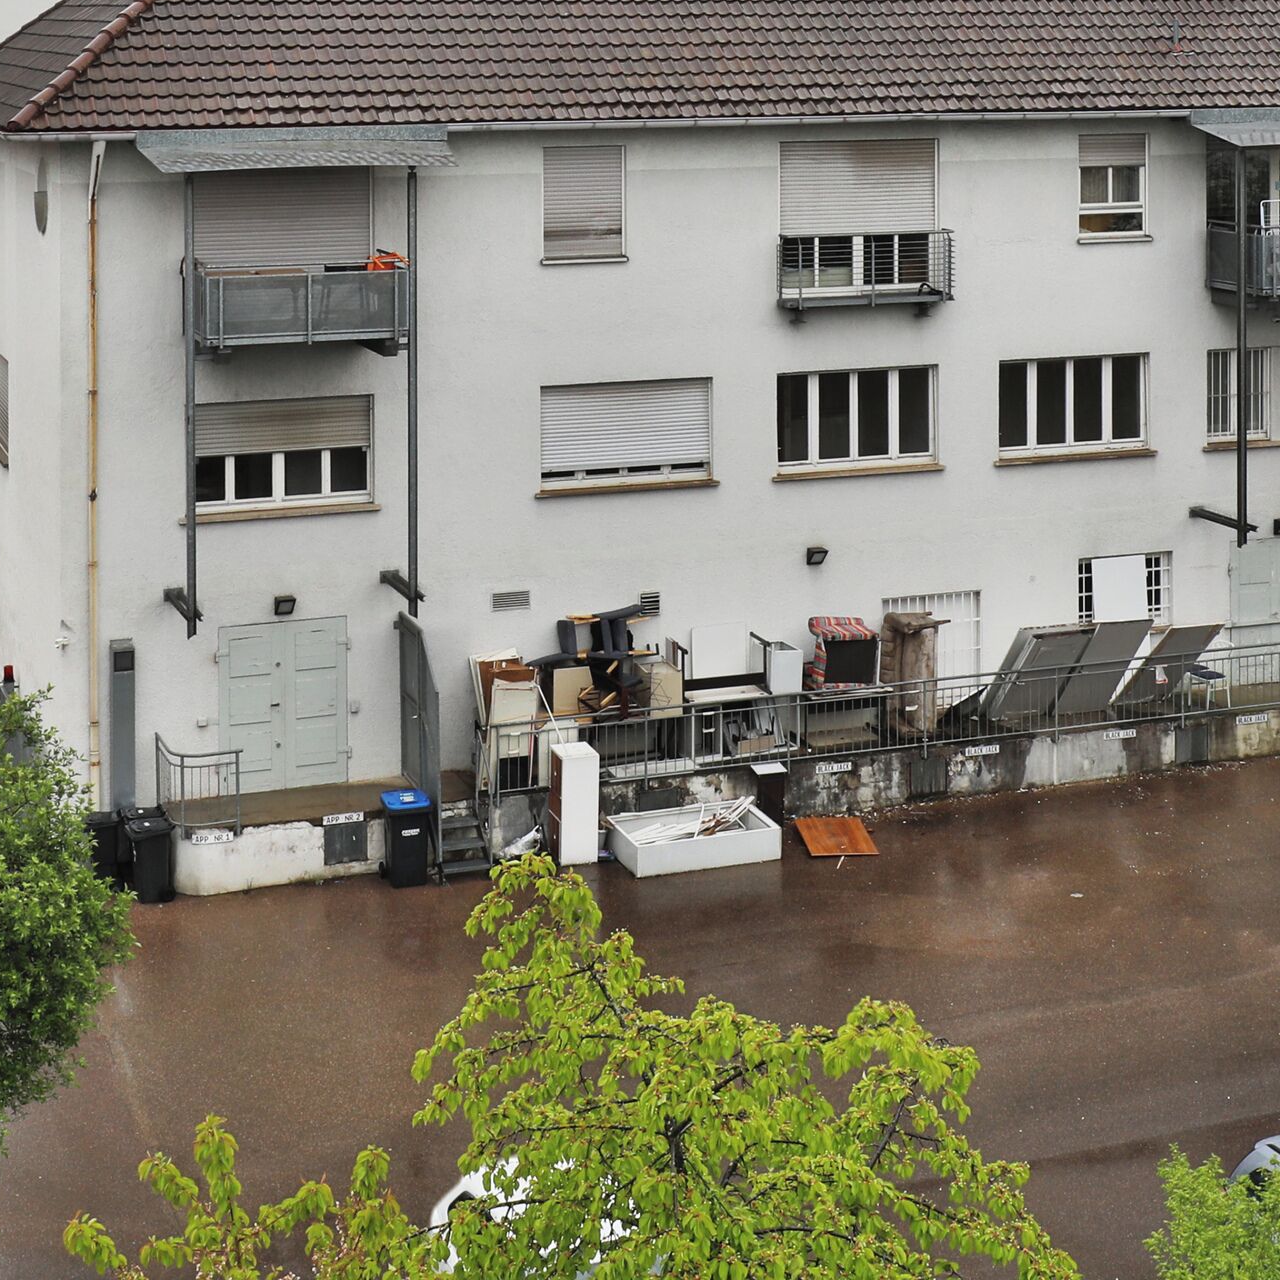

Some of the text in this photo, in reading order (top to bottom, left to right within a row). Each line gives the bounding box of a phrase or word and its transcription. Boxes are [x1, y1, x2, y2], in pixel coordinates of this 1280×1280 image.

[1105, 731, 1120, 739] BLACK
[967, 745, 997, 756] BLACK JACK
[818, 765, 834, 773] BLACK
